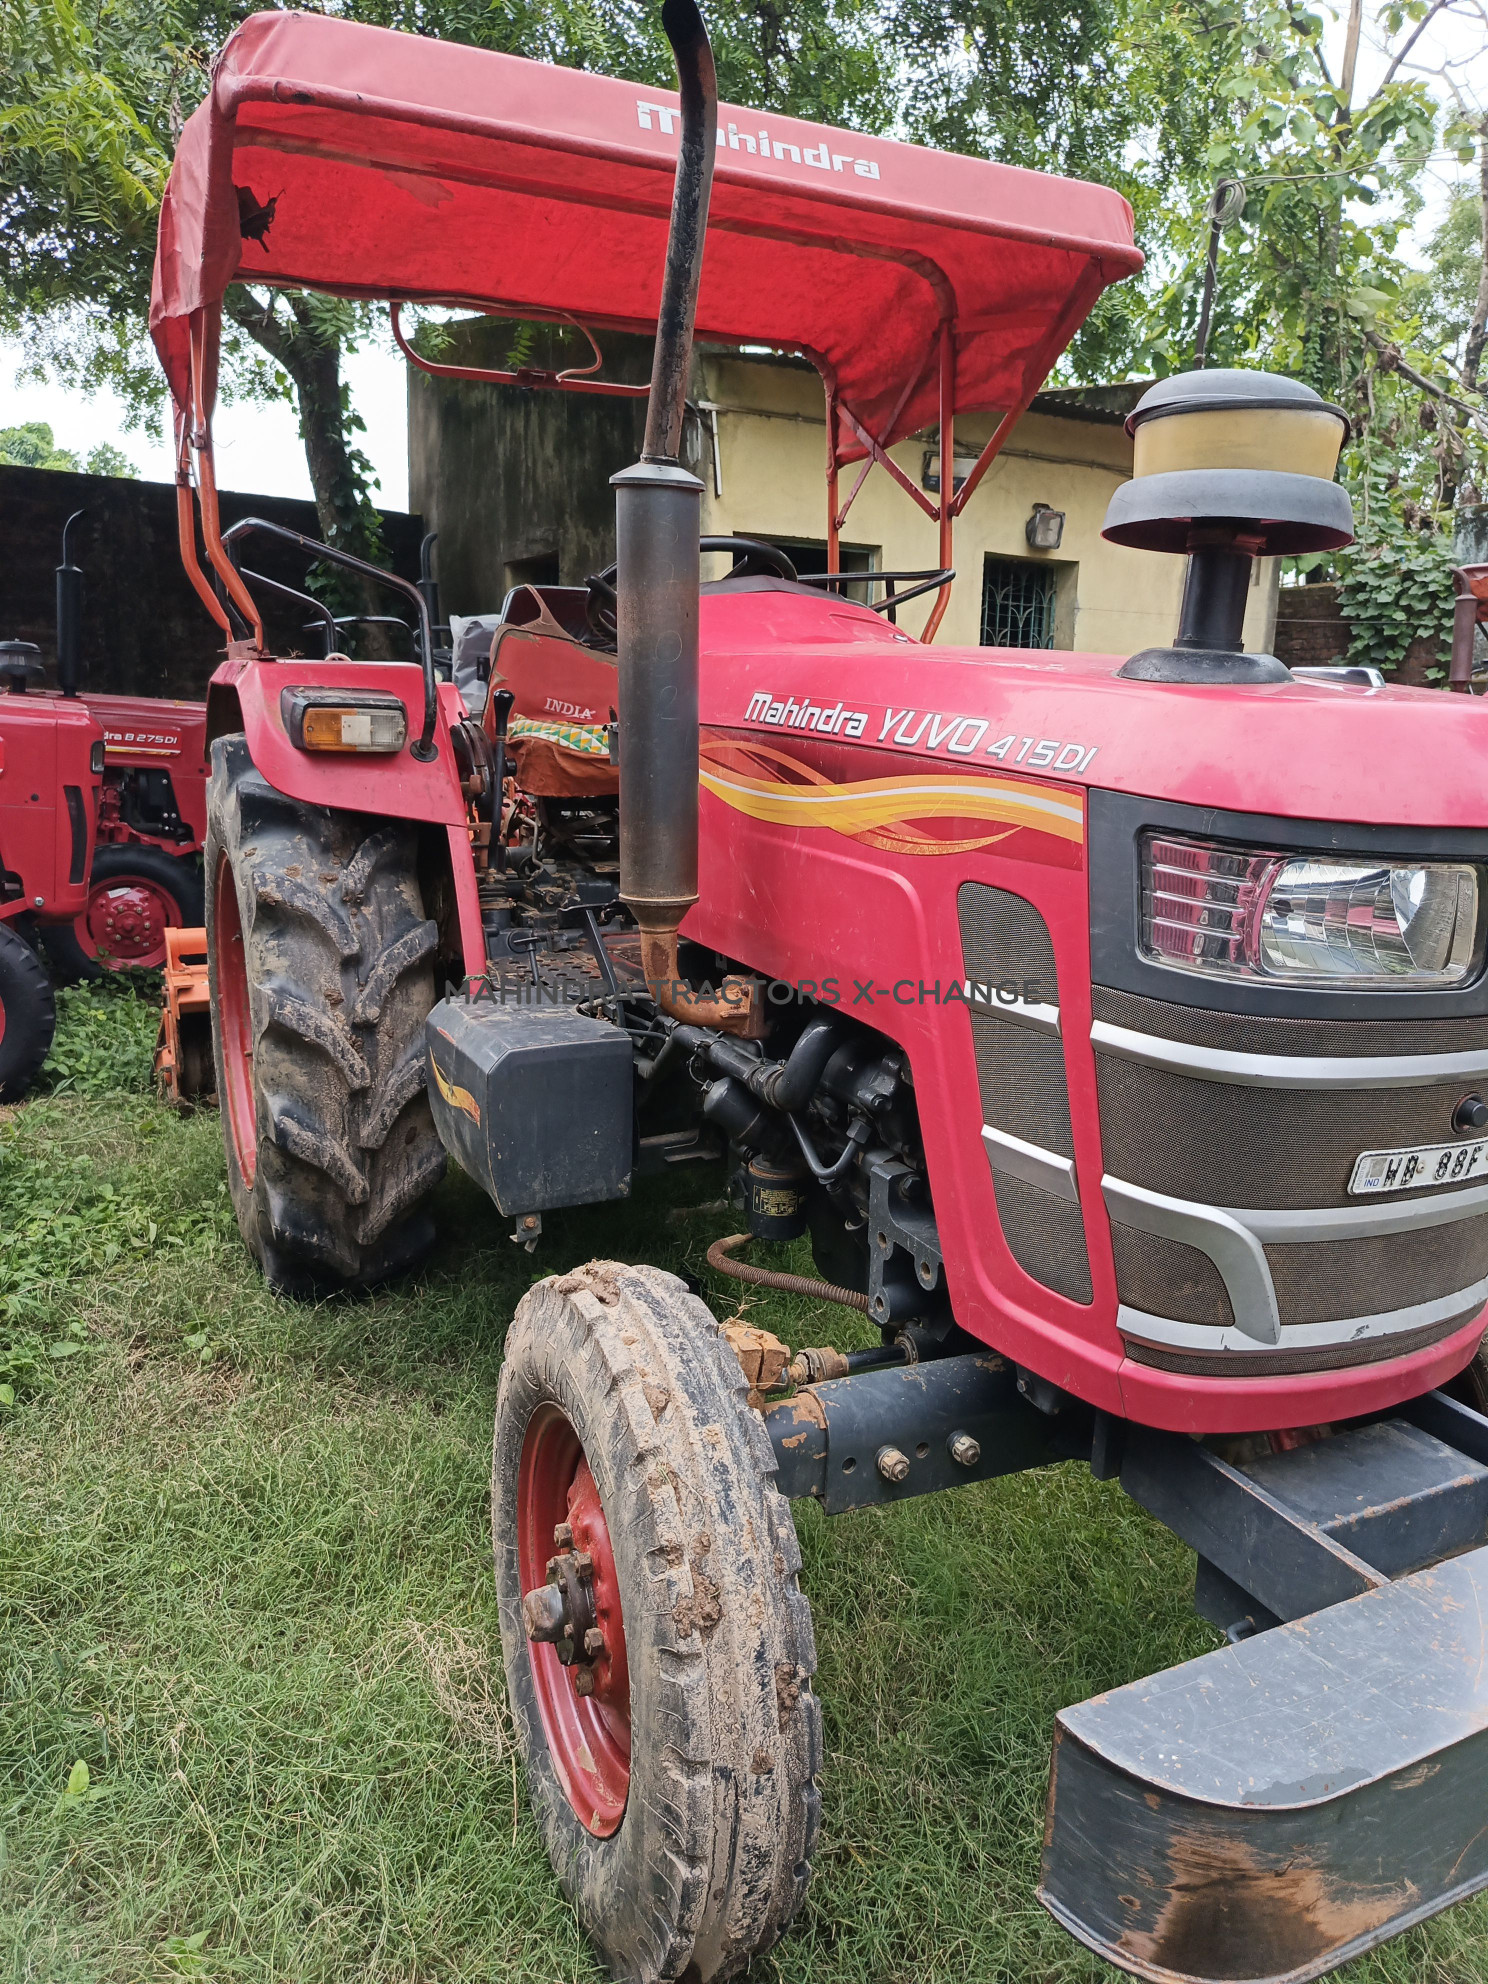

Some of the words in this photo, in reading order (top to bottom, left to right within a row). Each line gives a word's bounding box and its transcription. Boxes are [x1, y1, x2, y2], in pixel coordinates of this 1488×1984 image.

[544, 697, 596, 719] INDIA
[744, 692, 869, 738] Mahindra
[877, 708, 992, 755] YUVO
[986, 735, 1099, 775] 415DI
[1364, 1179, 1379, 1187] IND
